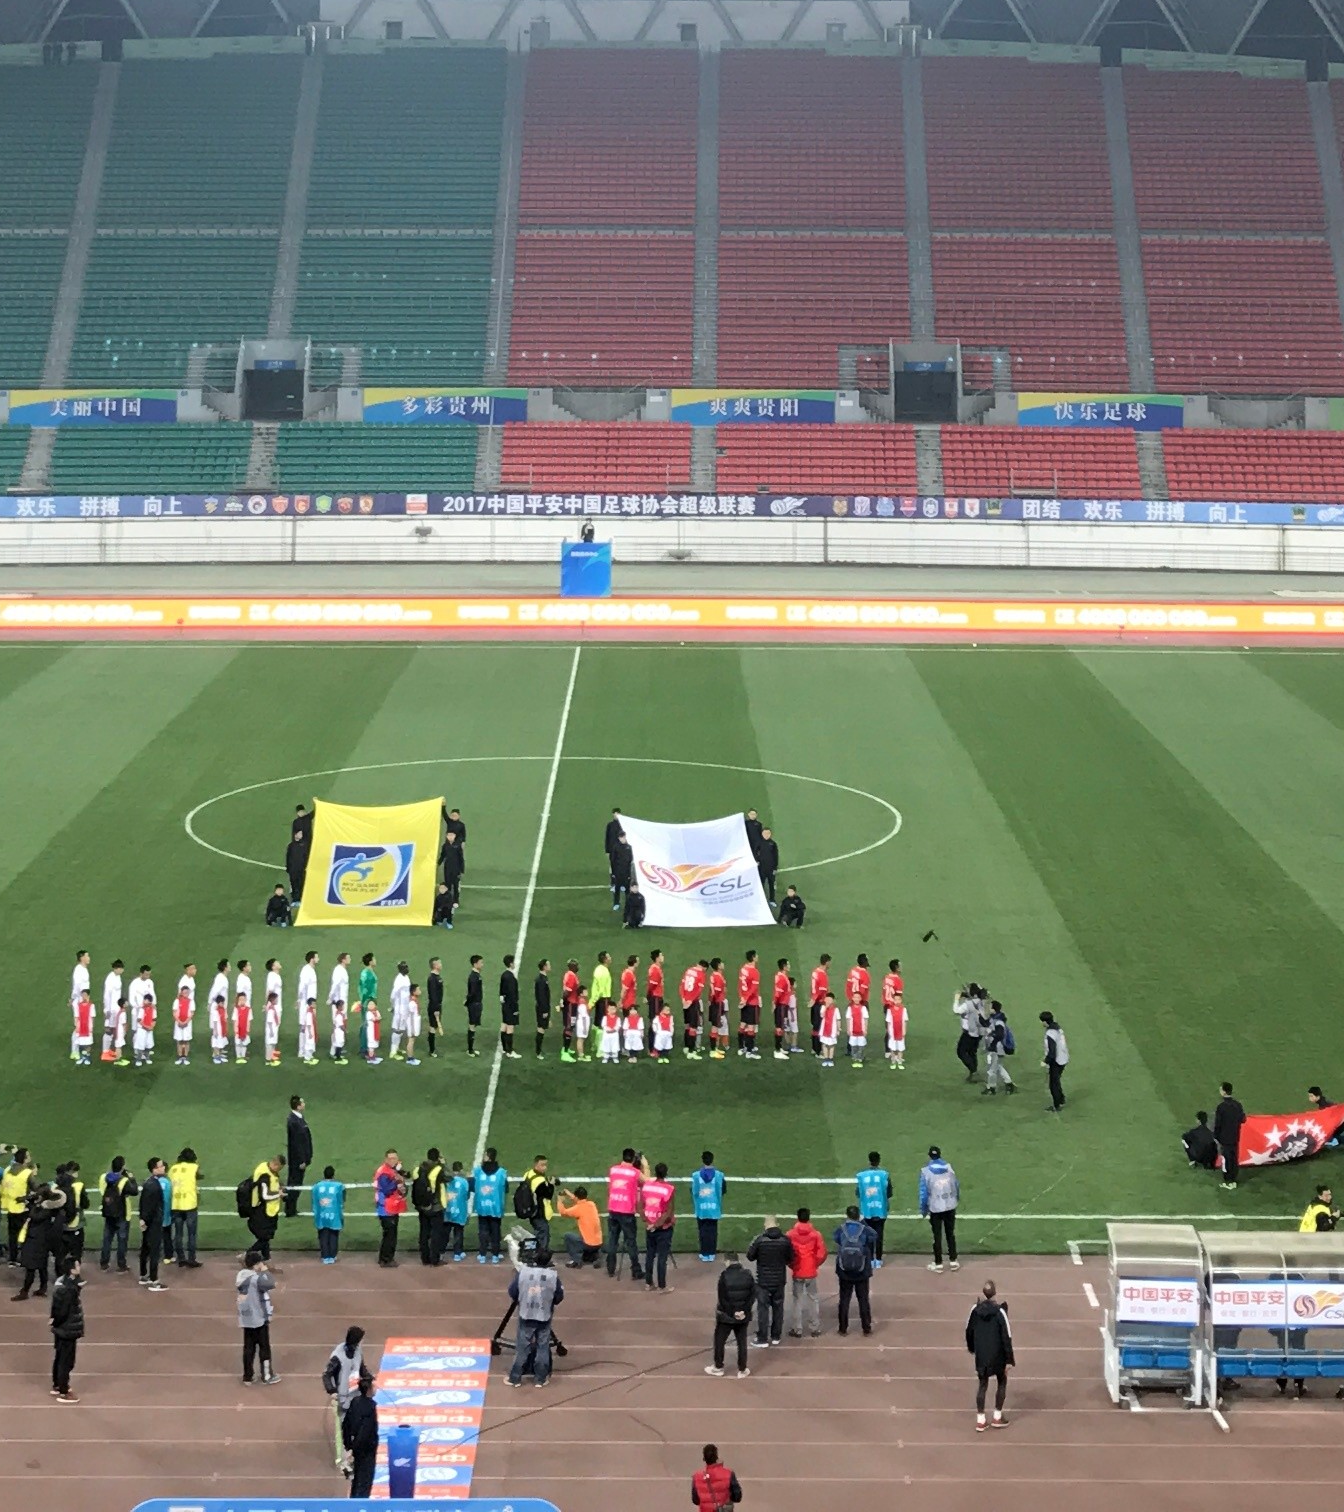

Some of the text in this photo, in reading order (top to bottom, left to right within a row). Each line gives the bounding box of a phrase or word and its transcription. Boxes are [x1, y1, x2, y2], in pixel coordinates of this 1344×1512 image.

[50, 396, 142, 418] 美丽中国
[401, 395, 492, 417] 多彩贵州
[709, 397, 800, 418] 爽爽贵阳
[1053, 400, 1147, 422] 快乐足球
[16, 496, 57, 517] 欢乐
[79, 496, 121, 517] 拼搏
[143, 495, 184, 516] 向上
[442, 494, 756, 516] 2017中国平安中国足球协会超级联赛
[1022, 498, 1247, 525] 团结 欢乐 拼搏 向上
[700, 875, 752, 897] CSL
[380, 898, 406, 907] FIFA
[1123, 1287, 1194, 1303] 中国平安
[1213, 1290, 1285, 1305] 中国平安
